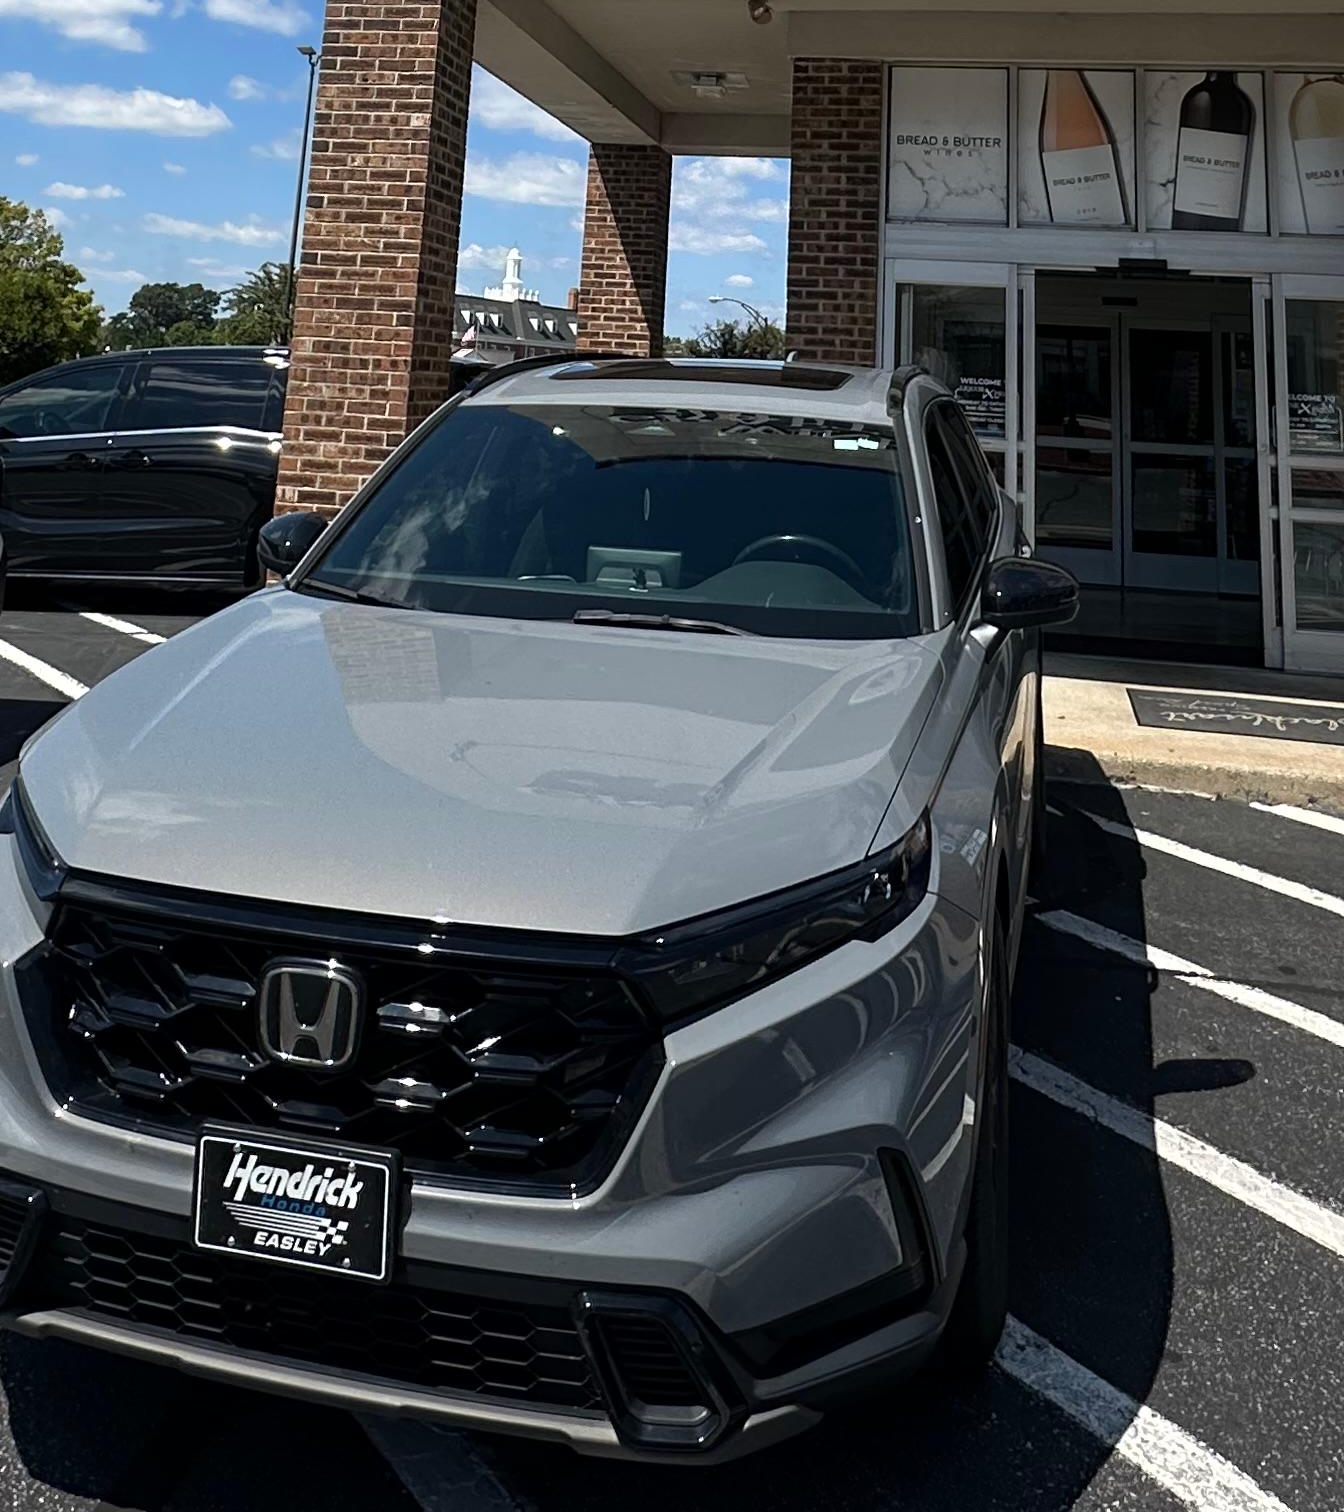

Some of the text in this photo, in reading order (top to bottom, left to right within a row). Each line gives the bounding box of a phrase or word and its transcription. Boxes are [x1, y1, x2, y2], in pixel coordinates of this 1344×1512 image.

[896, 134, 1002, 149] BREAD & BUTTER
[959, 377, 1002, 387] WELCOME
[223, 1152, 364, 1209] Hendrick
[260, 1193, 327, 1218] Honda
[253, 1230, 333, 1258] EASLEY
